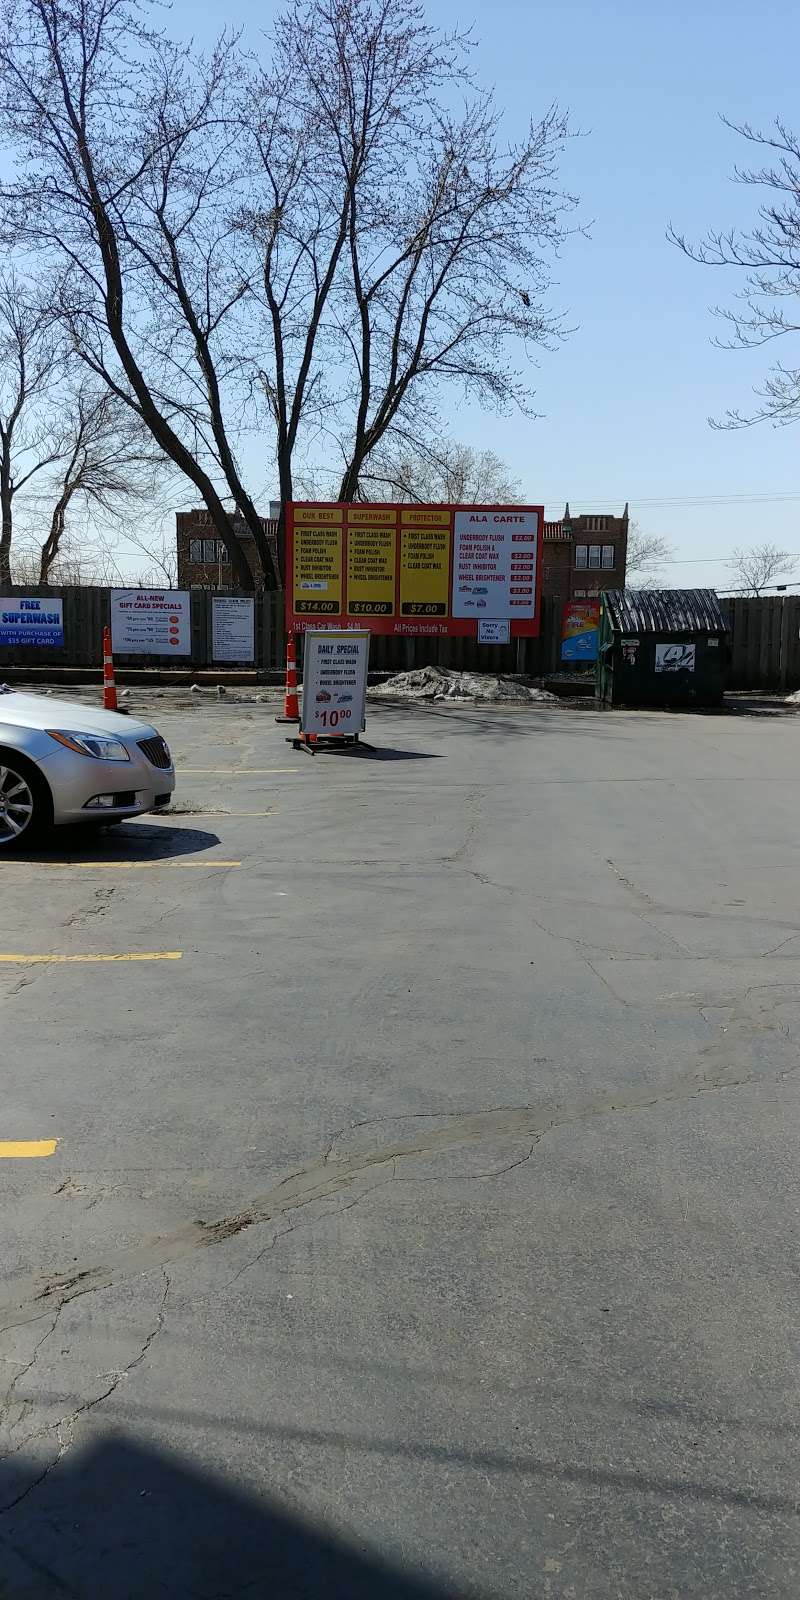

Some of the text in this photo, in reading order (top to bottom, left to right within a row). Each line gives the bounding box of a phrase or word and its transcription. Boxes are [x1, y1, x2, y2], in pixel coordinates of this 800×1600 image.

[318, 512, 334, 520] BEST
[20, 601, 40, 610] FREE
[300, 602, 333, 611] $14.00
[354, 604, 386, 612] $10.00
[410, 605, 438, 613] $7.00
[2, 612, 60, 624] SUPERWASH
[302, 622, 316, 630] Class
[317, 622, 326, 630] Car
[327, 622, 341, 630] Wash
[401, 624, 418, 633] Prices
[419, 624, 438, 633] Include
[439, 624, 448, 633] Tax
[318, 645, 359, 654] DAILY SPECIAL
